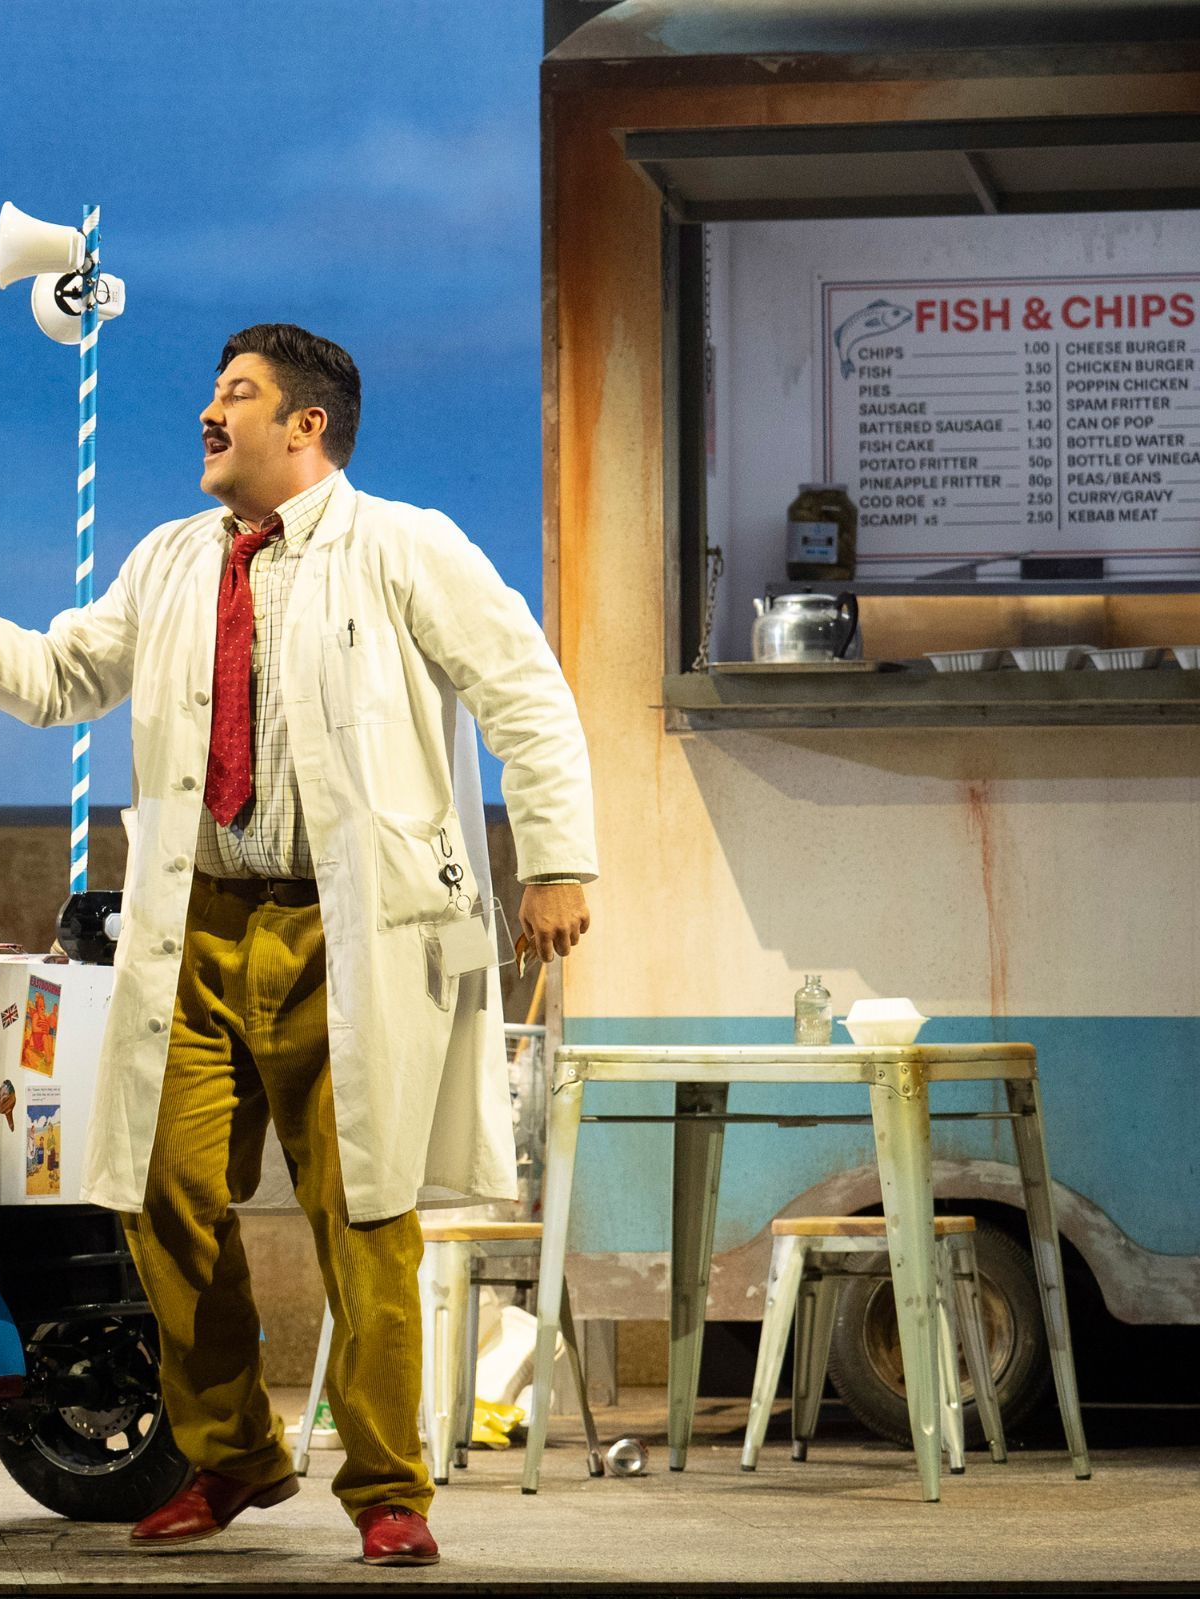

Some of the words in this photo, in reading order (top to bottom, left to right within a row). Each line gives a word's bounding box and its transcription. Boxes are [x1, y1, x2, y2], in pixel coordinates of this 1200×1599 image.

[915, 298, 1010, 333] FISH
[1022, 296, 1053, 331] &
[1061, 292, 1195, 329] CHIPS
[858, 347, 904, 361] CHIPS
[1024, 341, 1050, 355] 1.00
[1065, 341, 1122, 355] CHEESE
[1126, 339, 1186, 353] BURGER
[858, 366, 892, 379] FISH
[1025, 362, 1051, 375] 3.50
[1065, 360, 1131, 374] CHICKEN
[1135, 358, 1194, 372] BURGER
[858, 385, 891, 398] PIES
[1025, 381, 1051, 394] 2.50
[1066, 379, 1119, 393] POPPIN
[1123, 378, 1188, 391] CHICKEN
[858, 402, 927, 416] SAUSAGE
[1027, 400, 1051, 413] 1.30
[1066, 398, 1107, 412] SPAM
[1111, 397, 1170, 410] FRITTER
[859, 421, 932, 435] BATTERED
[935, 419, 1003, 433] SAUSAGE
[1027, 418, 1051, 431] 1.40
[1066, 417, 1098, 430] CAN
[1101, 416, 1120, 430] OF
[1123, 415, 1154, 429] POP
[859, 440, 892, 453] FISH
[895, 439, 934, 452] CAKE
[1027, 436, 1052, 449] 1.30
[1066, 435, 1132, 449] BOTTLED
[1135, 434, 1185, 448] WATER
[859, 458, 916, 472] POTATO
[919, 456, 978, 470] FRITTER
[1028, 455, 1052, 469] 50p
[1067, 454, 1122, 468] BOTTLE
[1125, 453, 1144, 466] OF
[859, 477, 938, 490] PINEAPPLE
[941, 475, 1002, 489] FRITTER
[1028, 473, 1052, 488] 80p
[1067, 471, 1162, 487] PEAS/BEANS
[859, 495, 892, 509] COD
[896, 494, 926, 508] ROE
[1027, 492, 1053, 506] 2.50
[1067, 490, 1173, 505] CURRY/GRAVY
[860, 514, 917, 527] SCAMPI
[1027, 511, 1053, 525] 2.50
[1068, 509, 1115, 523] KEBAB
[1118, 508, 1159, 522] MEAT
